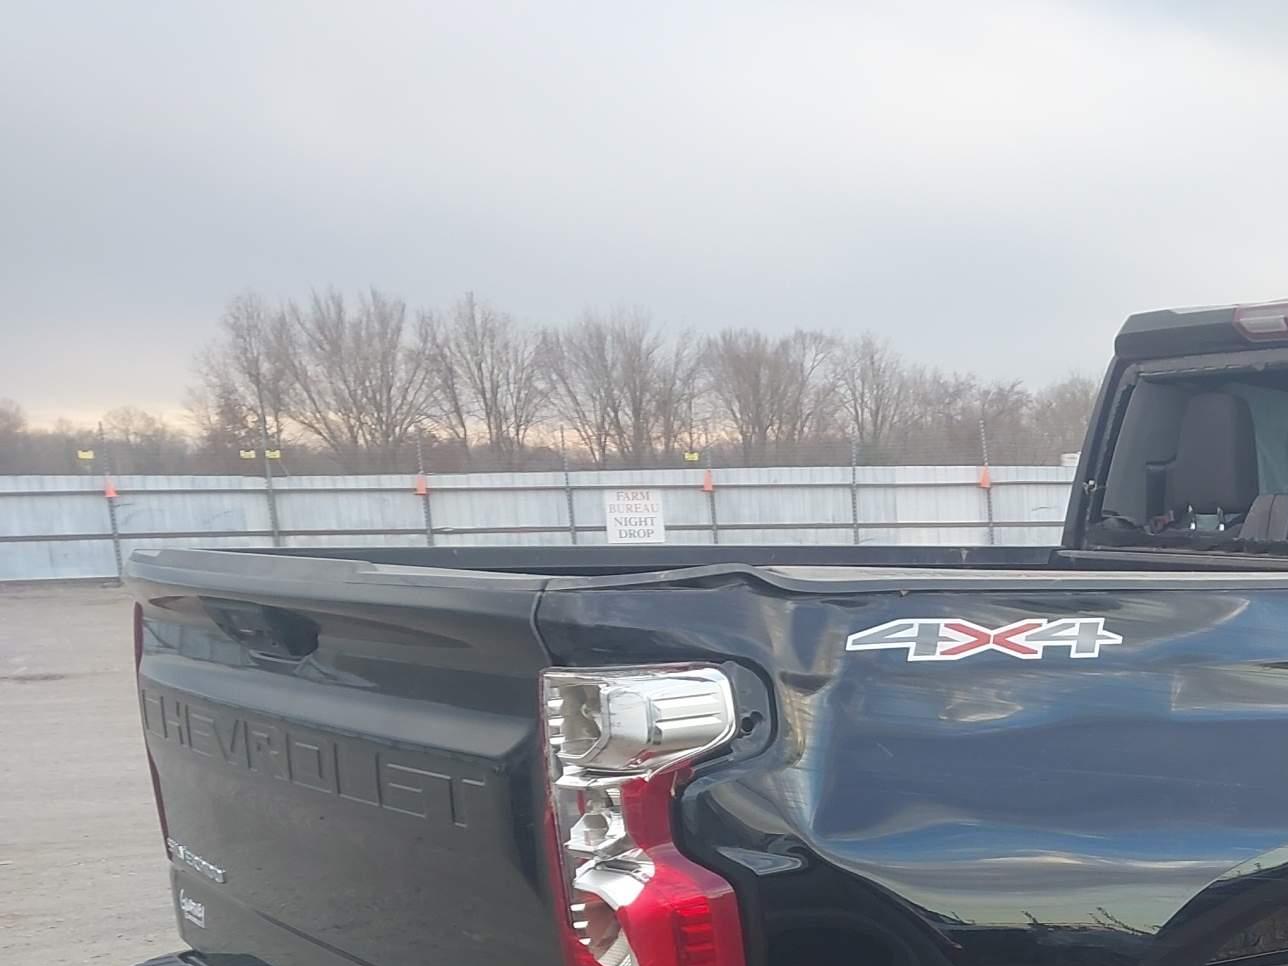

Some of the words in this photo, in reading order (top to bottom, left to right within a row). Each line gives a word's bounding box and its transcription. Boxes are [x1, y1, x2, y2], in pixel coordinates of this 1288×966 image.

[616, 491, 651, 501] FARM
[608, 503, 659, 513] BUREAU
[614, 517, 657, 527] NIGHT
[618, 529, 655, 539] DROP
[141, 688, 487, 829] CHEVROLET
